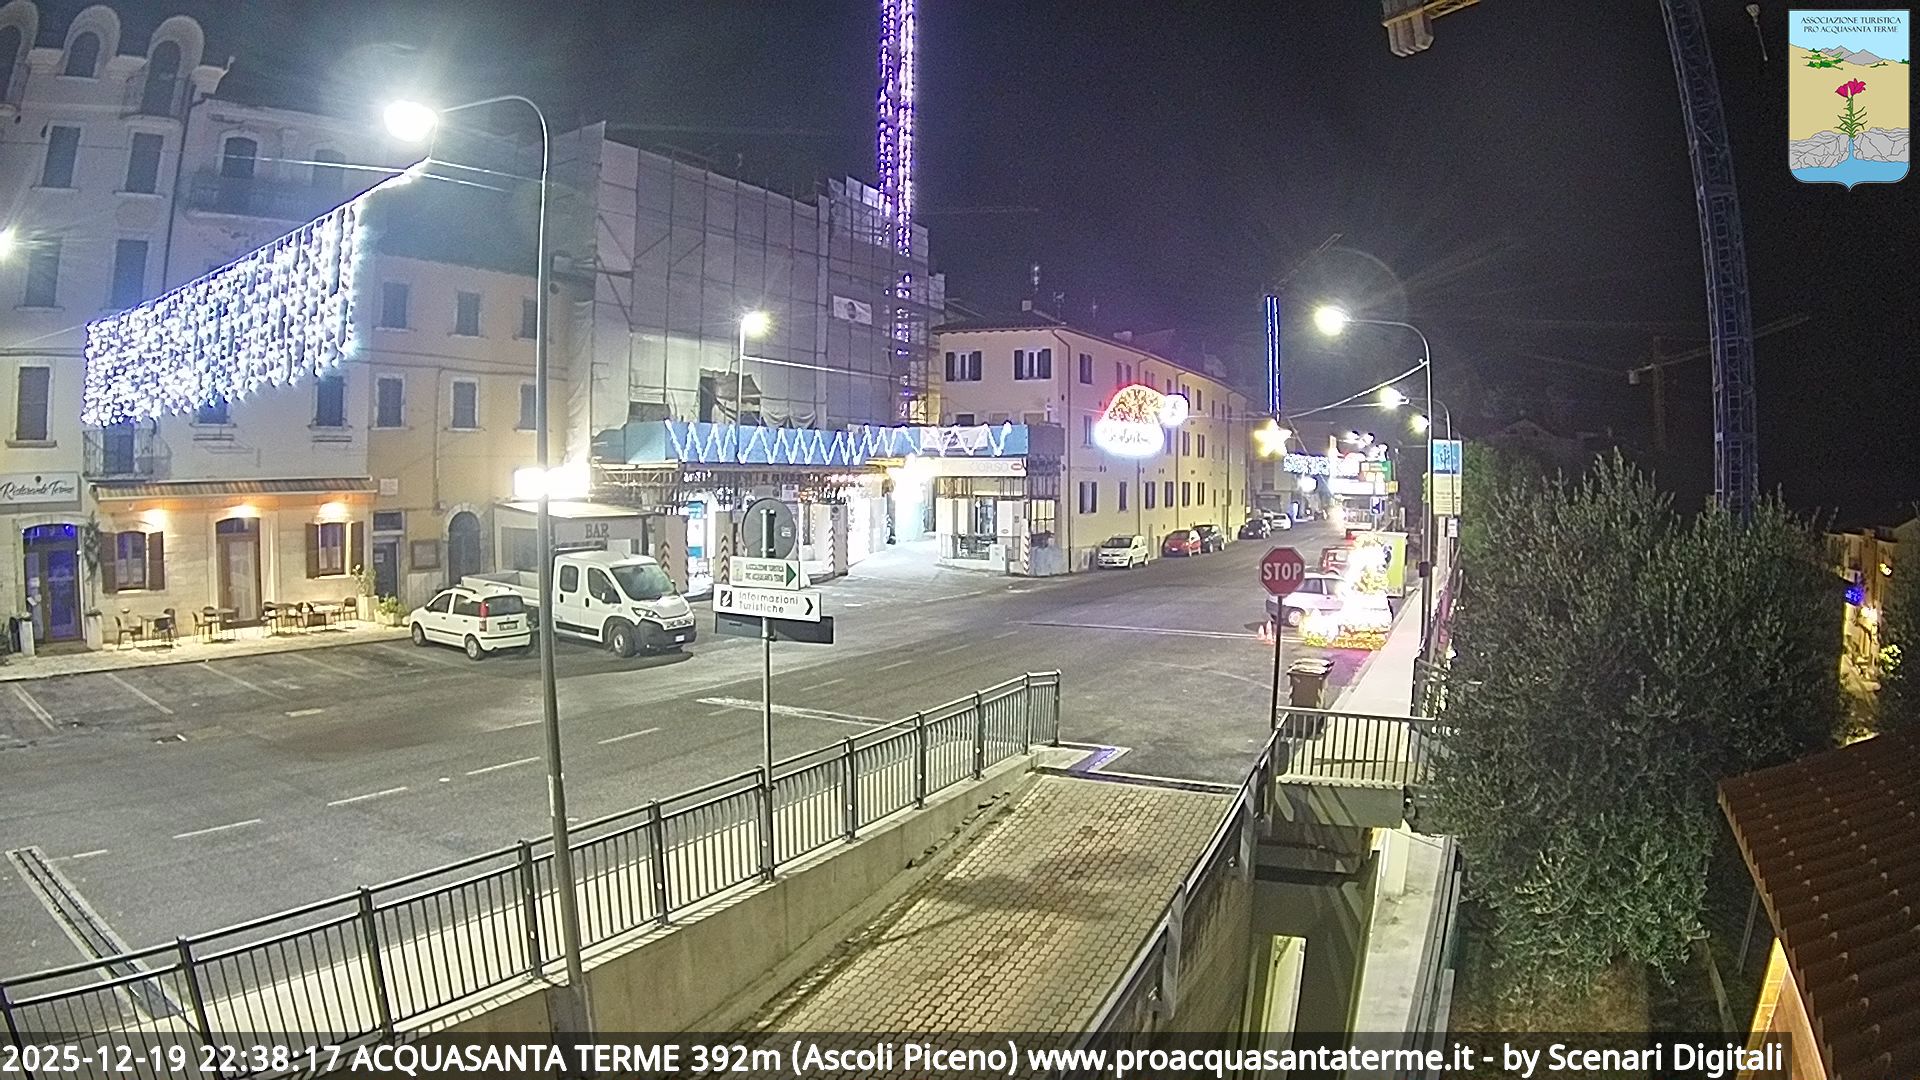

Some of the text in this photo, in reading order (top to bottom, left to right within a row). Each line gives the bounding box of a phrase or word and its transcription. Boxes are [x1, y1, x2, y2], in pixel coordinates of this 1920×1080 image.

[585, 523, 609, 538] BAR
[1263, 562, 1302, 580] STOP
[739, 591, 799, 605] Informazioni
[739, 601, 784, 614] Turistiche
